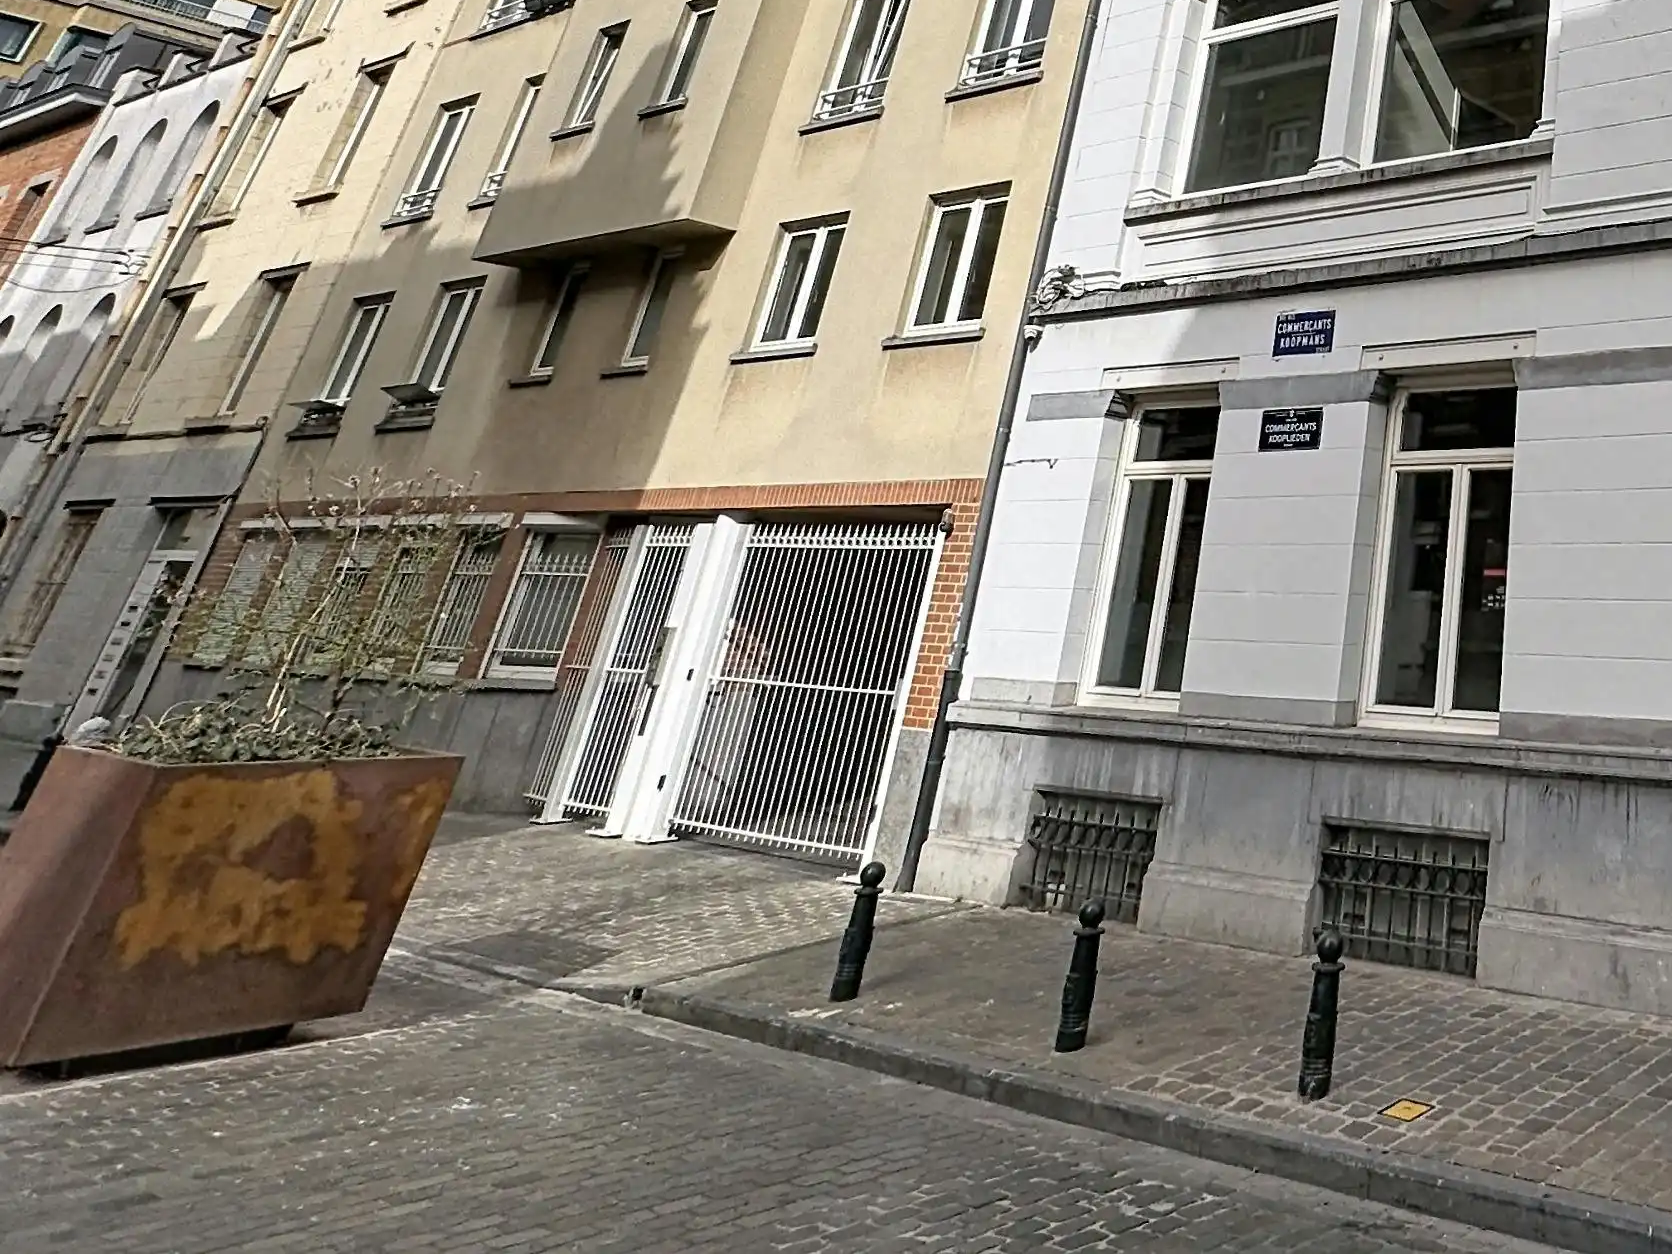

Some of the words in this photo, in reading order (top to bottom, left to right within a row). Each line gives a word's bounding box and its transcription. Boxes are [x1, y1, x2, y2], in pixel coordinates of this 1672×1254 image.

[1278, 318, 1331, 334] COMMERÇANTS
[1280, 334, 1325, 349] KOOPMANS
[1265, 422, 1317, 433] COMMERÇANTS
